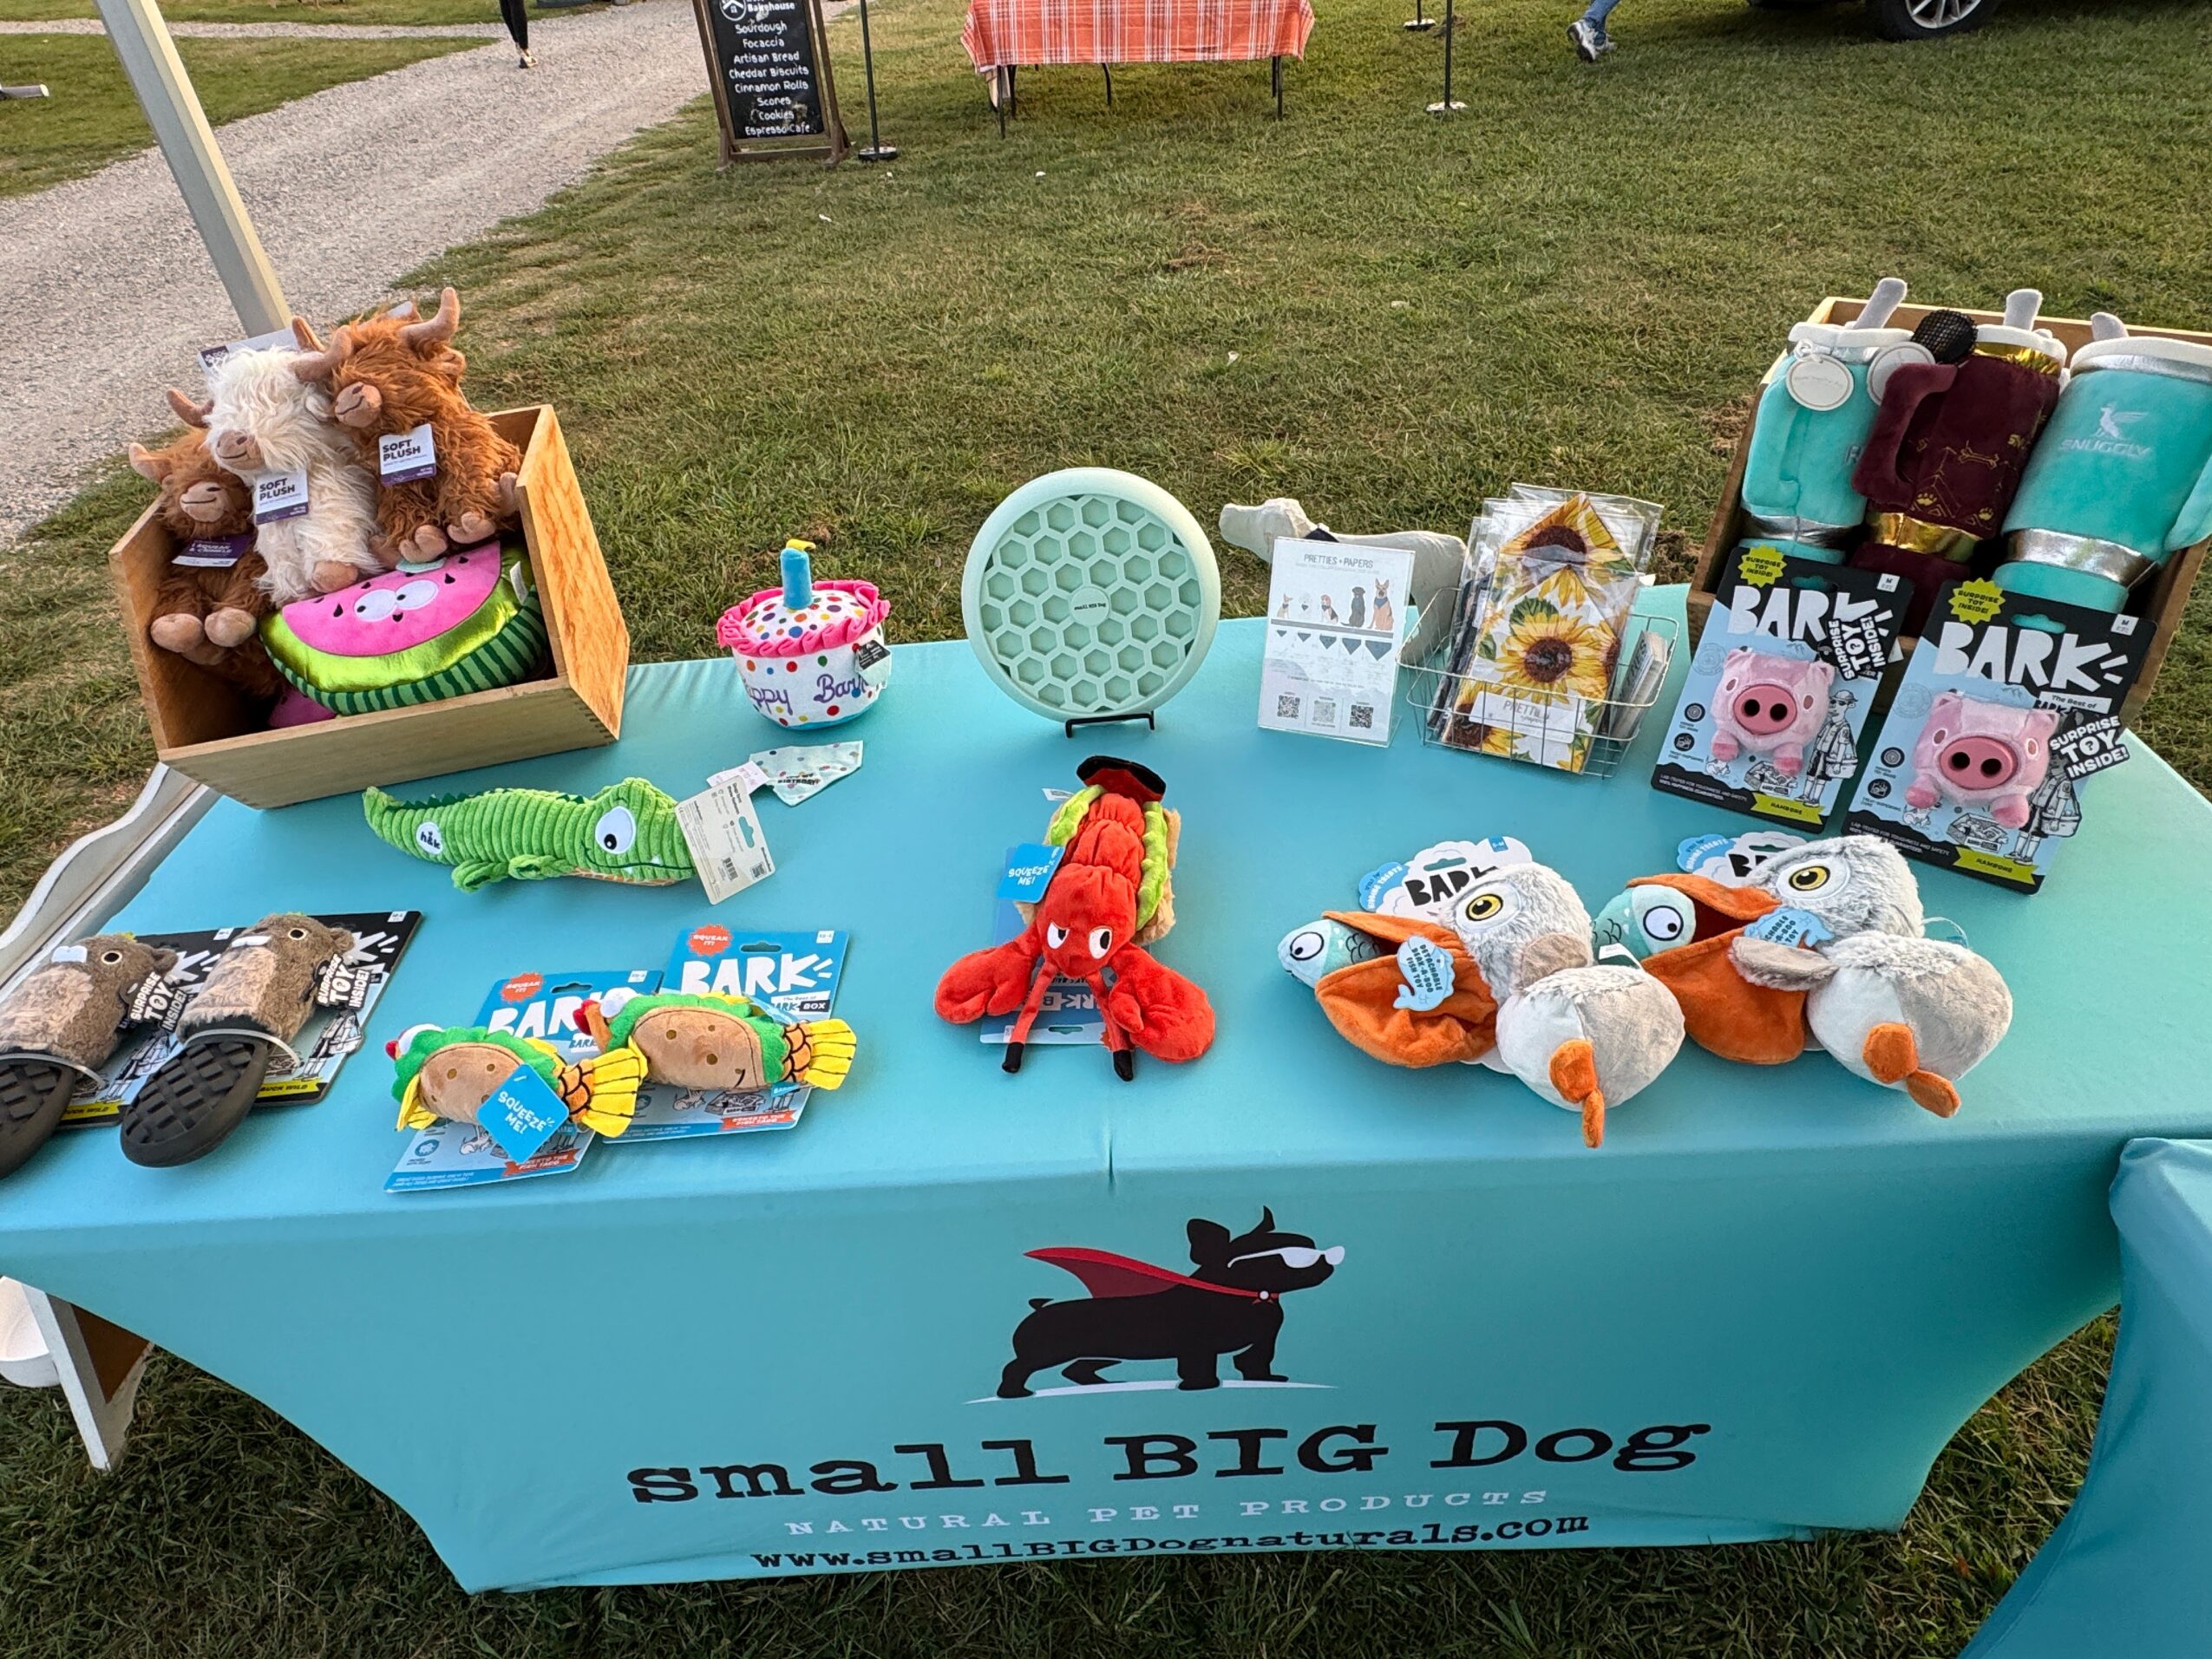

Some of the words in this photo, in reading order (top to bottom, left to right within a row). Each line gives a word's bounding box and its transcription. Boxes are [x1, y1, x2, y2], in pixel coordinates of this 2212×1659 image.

[747, 2, 795, 12] Bakehouse
[735, 20, 787, 35] Sourdough
[743, 36, 785, 49] Focaccia
[733, 53, 769, 64] Artisan
[771, 51, 800, 62] Bread
[729, 69, 767, 79] Cheddar
[769, 65, 809, 77] Biscuits
[735, 82, 781, 94] Cinnamon
[783, 80, 808, 90] Rolls
[756, 96, 791, 107] Scones
[758, 109, 795, 121] Cookies
[744, 126, 786, 137] Espresso
[789, 121, 810, 134] Cafe
[383, 439, 412, 454] SOFT
[383, 446, 421, 461] PLUSH
[2058, 438, 2152, 457] SNUGGLY
[259, 478, 287, 493] SOFT
[259, 485, 295, 501] PLUSH
[1304, 553, 1337, 565] PRETTIES
[1344, 557, 1374, 569] PAPERS
[1745, 557, 1781, 568] SURPRISE
[1746, 568, 1773, 578] INSIDE!
[1958, 590, 1999, 604] SURPRISE
[1968, 598, 1984, 606] TOY
[1958, 602, 1989, 615] INSIDE!
[1828, 620, 1855, 680] SURPRISE
[1841, 622, 1870, 672] TOY
[1860, 616, 1887, 668] INSIDE!
[1933, 621, 2112, 693] BARK
[2052, 695, 2066, 703] The
[2067, 697, 2083, 707] Best
[2049, 715, 2121, 751] SURPRISE
[2060, 728, 2117, 763] TOY
[2067, 747, 2129, 779] INSIDE!
[1770, 802, 1803, 815] HAMBONE
[1008, 865, 1050, 878] SQUEEZE
[1976, 858, 2013, 873] HAMBONE
[1018, 876, 1036, 886] ME!
[1784, 930, 1798, 943] TOY
[680, 953, 821, 996] BARK
[1406, 957, 1417, 973] FISH
[1413, 974, 1423, 988] TOY
[1411, 947, 1434, 993] BEAK-A-BOO
[1419, 944, 1443, 990] DETACHABLE
[317, 953, 343, 1004] SURPRISE
[330, 963, 356, 1003] TOY
[507, 980, 540, 990] SQUEAK
[130, 971, 161, 1021] SURPRISE
[349, 969, 370, 1008] INSIDE!
[143, 981, 173, 1020] TOY
[161, 990, 187, 1031] INSIDE!
[498, 1091, 546, 1133] SQUEEZE
[505, 1113, 527, 1134] ME!
[627, 1439, 1070, 1504] small
[1103, 1424, 1389, 1481] BIG
[1430, 1420, 1711, 1472] Dog
[784, 1511, 1050, 1536] NATURAL
[1087, 1504, 1201, 1524] PET
[1240, 1490, 1548, 1517] PRODUCTS
[750, 1515, 1590, 1568] www.smallBIGDognaturals.com
